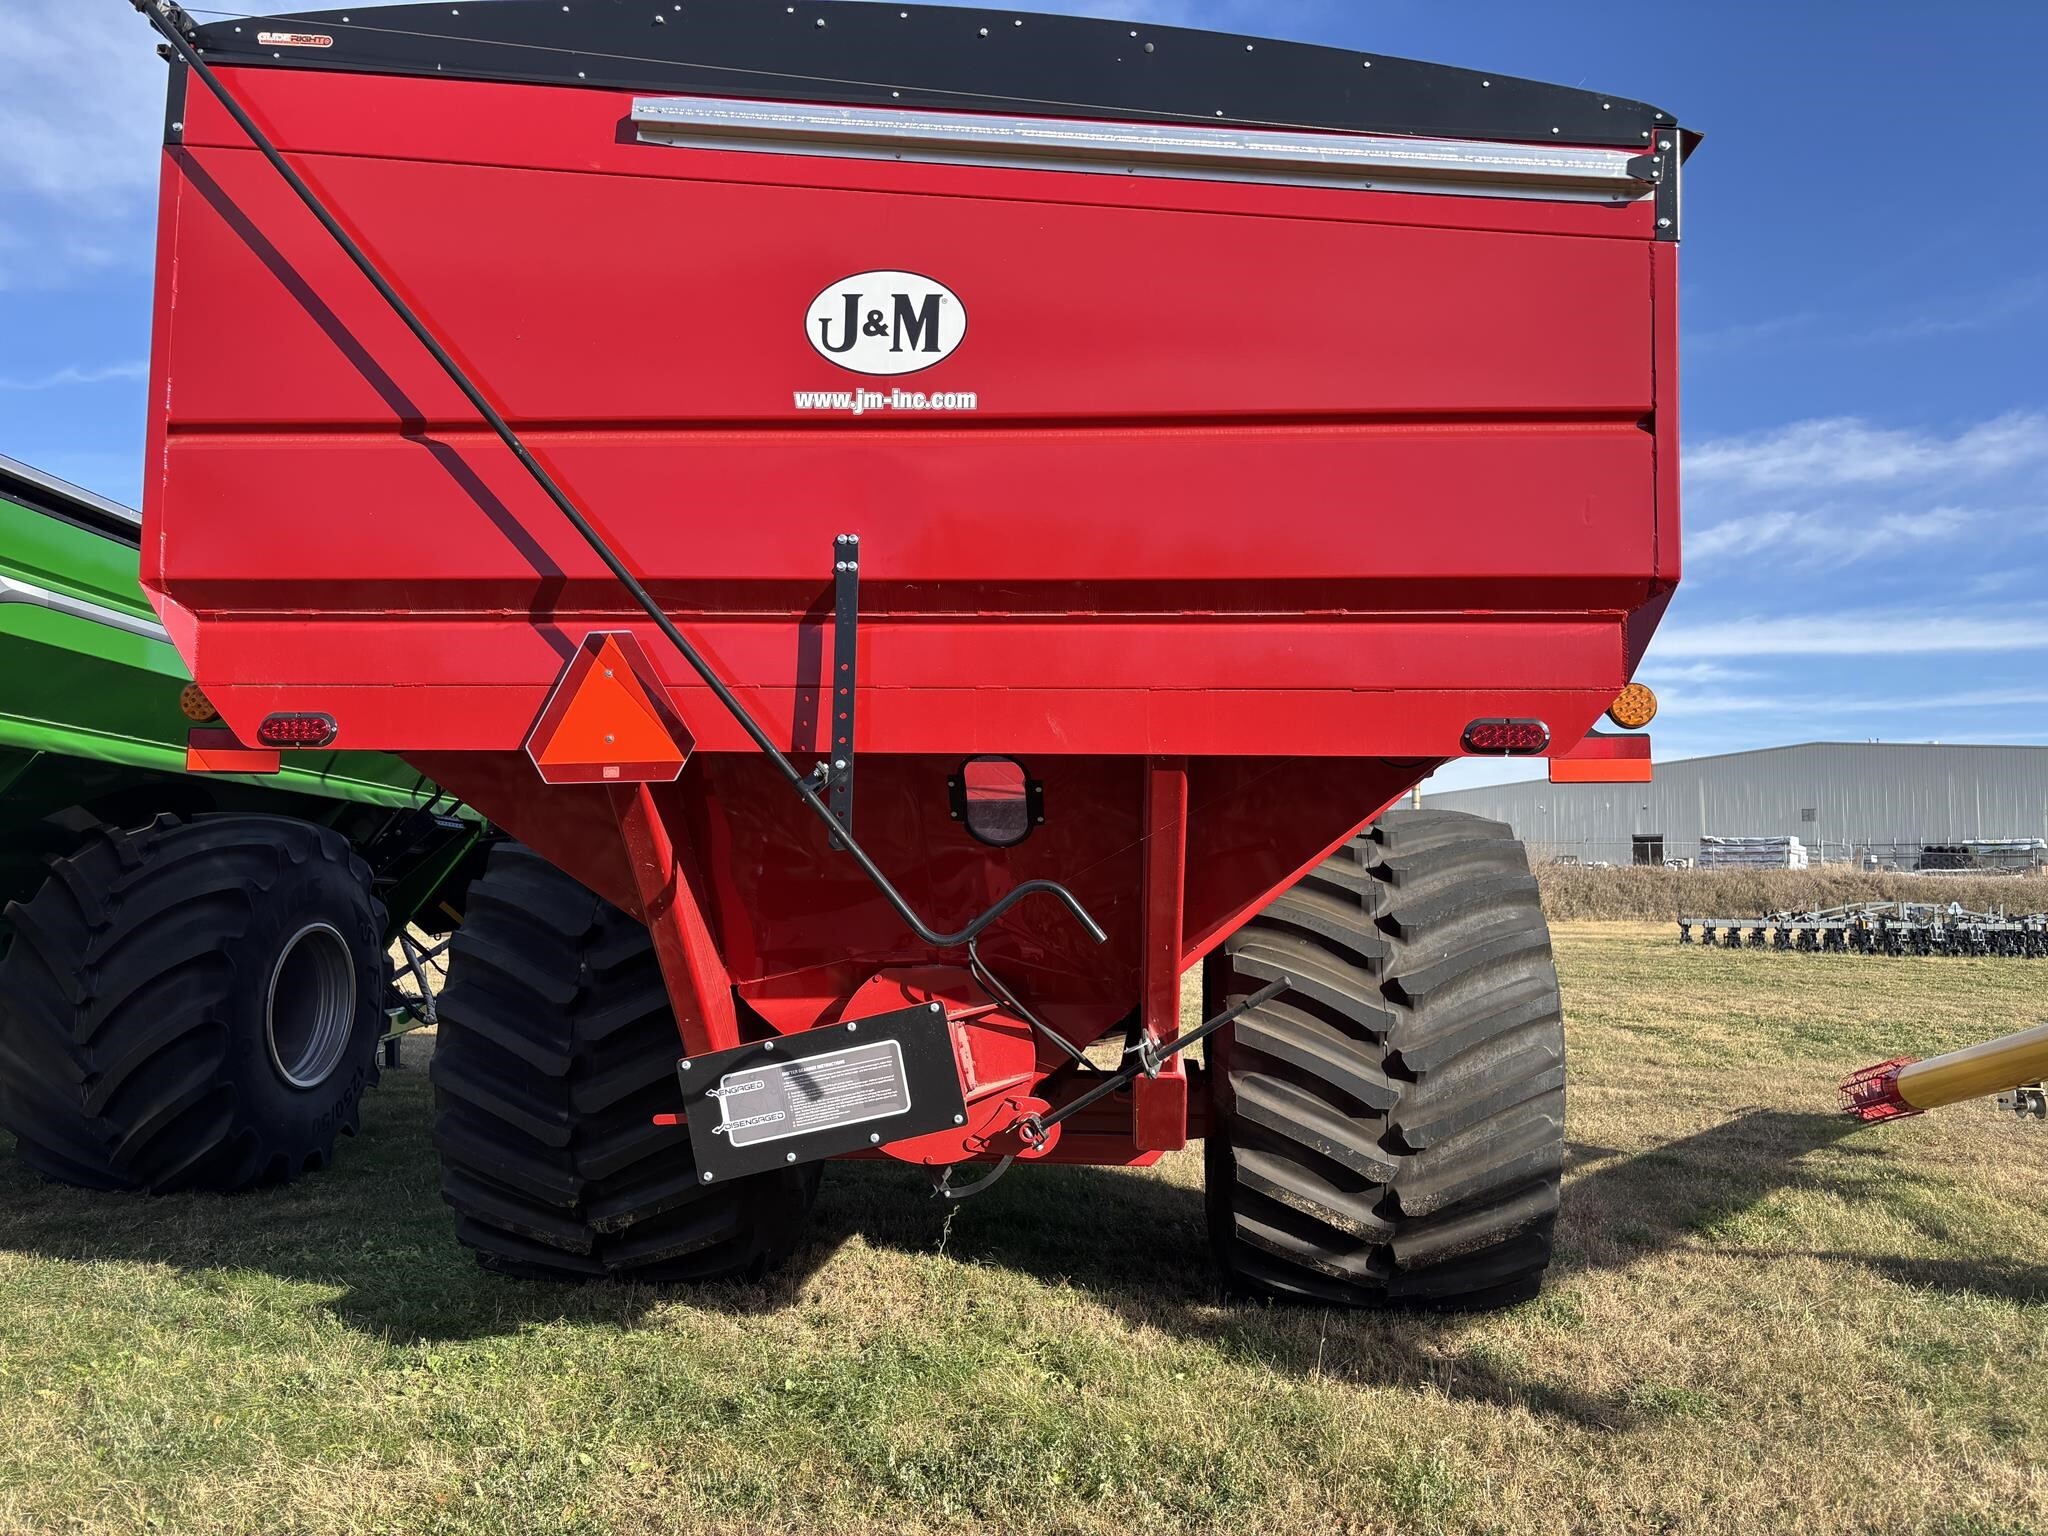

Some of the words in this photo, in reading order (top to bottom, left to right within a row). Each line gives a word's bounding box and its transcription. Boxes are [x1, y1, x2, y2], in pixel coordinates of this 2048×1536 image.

[818, 293, 943, 353] J&M
[793, 388, 977, 415] www.jm-inc.com
[717, 1081, 763, 1096] ENGAGED
[724, 1111, 785, 1130] DISENGAGED
